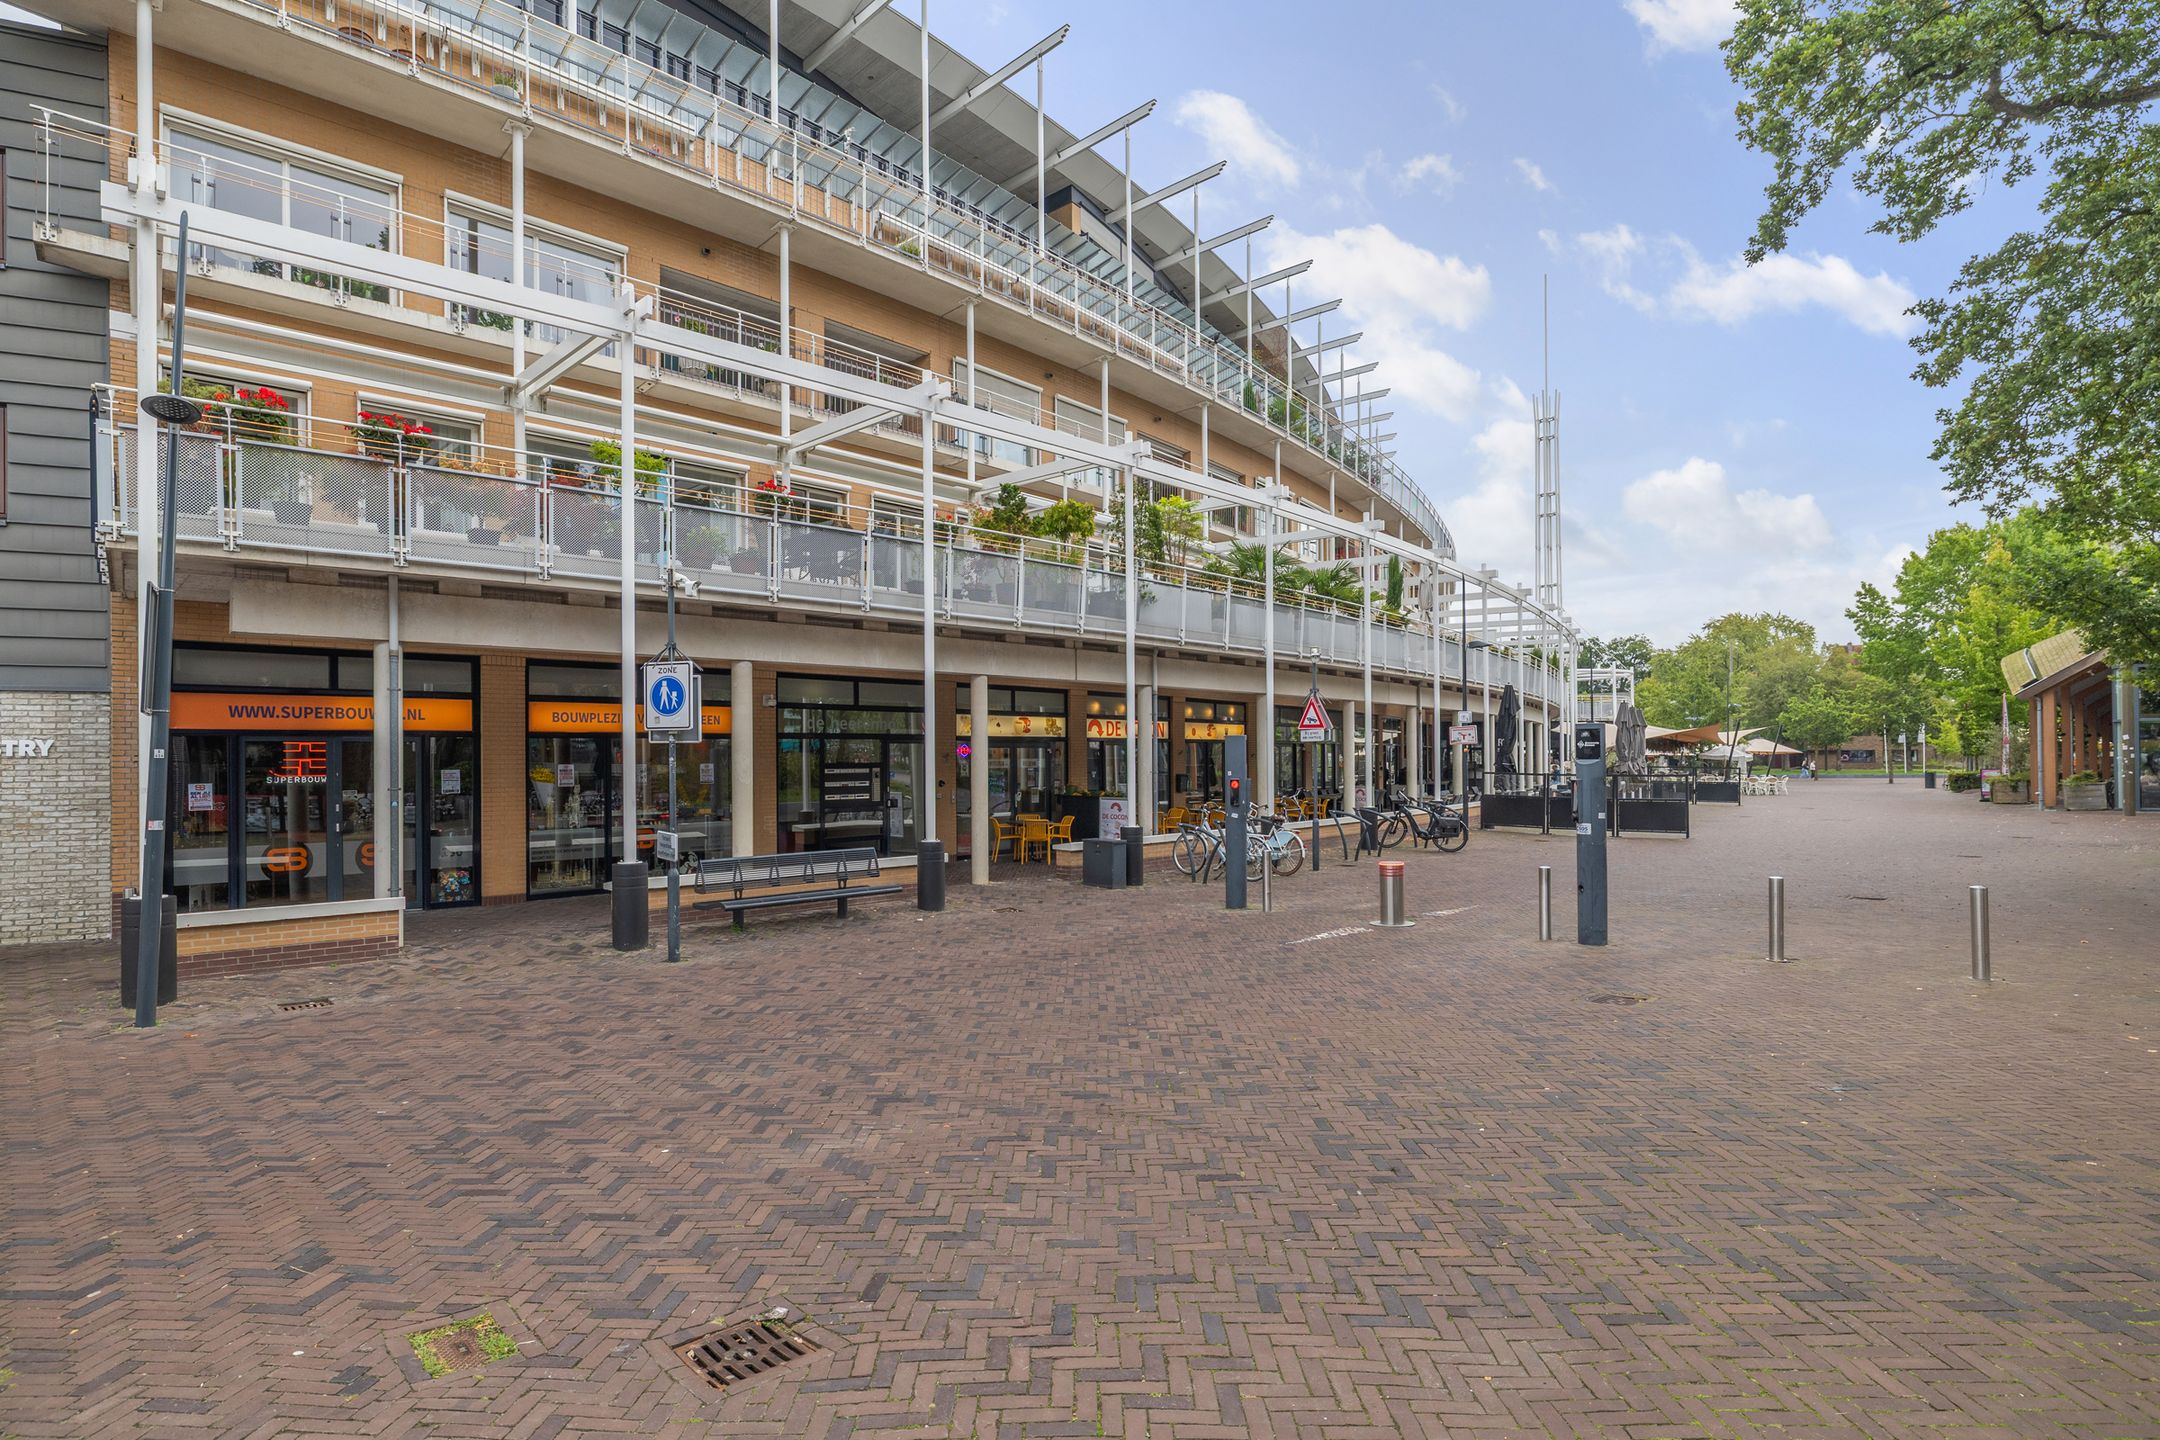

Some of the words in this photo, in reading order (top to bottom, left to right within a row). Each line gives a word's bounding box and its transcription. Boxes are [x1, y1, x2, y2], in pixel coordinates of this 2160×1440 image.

[552, 711, 624, 724] BOUWPLEZI
[1106, 721, 1122, 737] DE
[0, 738, 55, 757] TRY
[266, 776, 328, 784] SUPERBOUW
